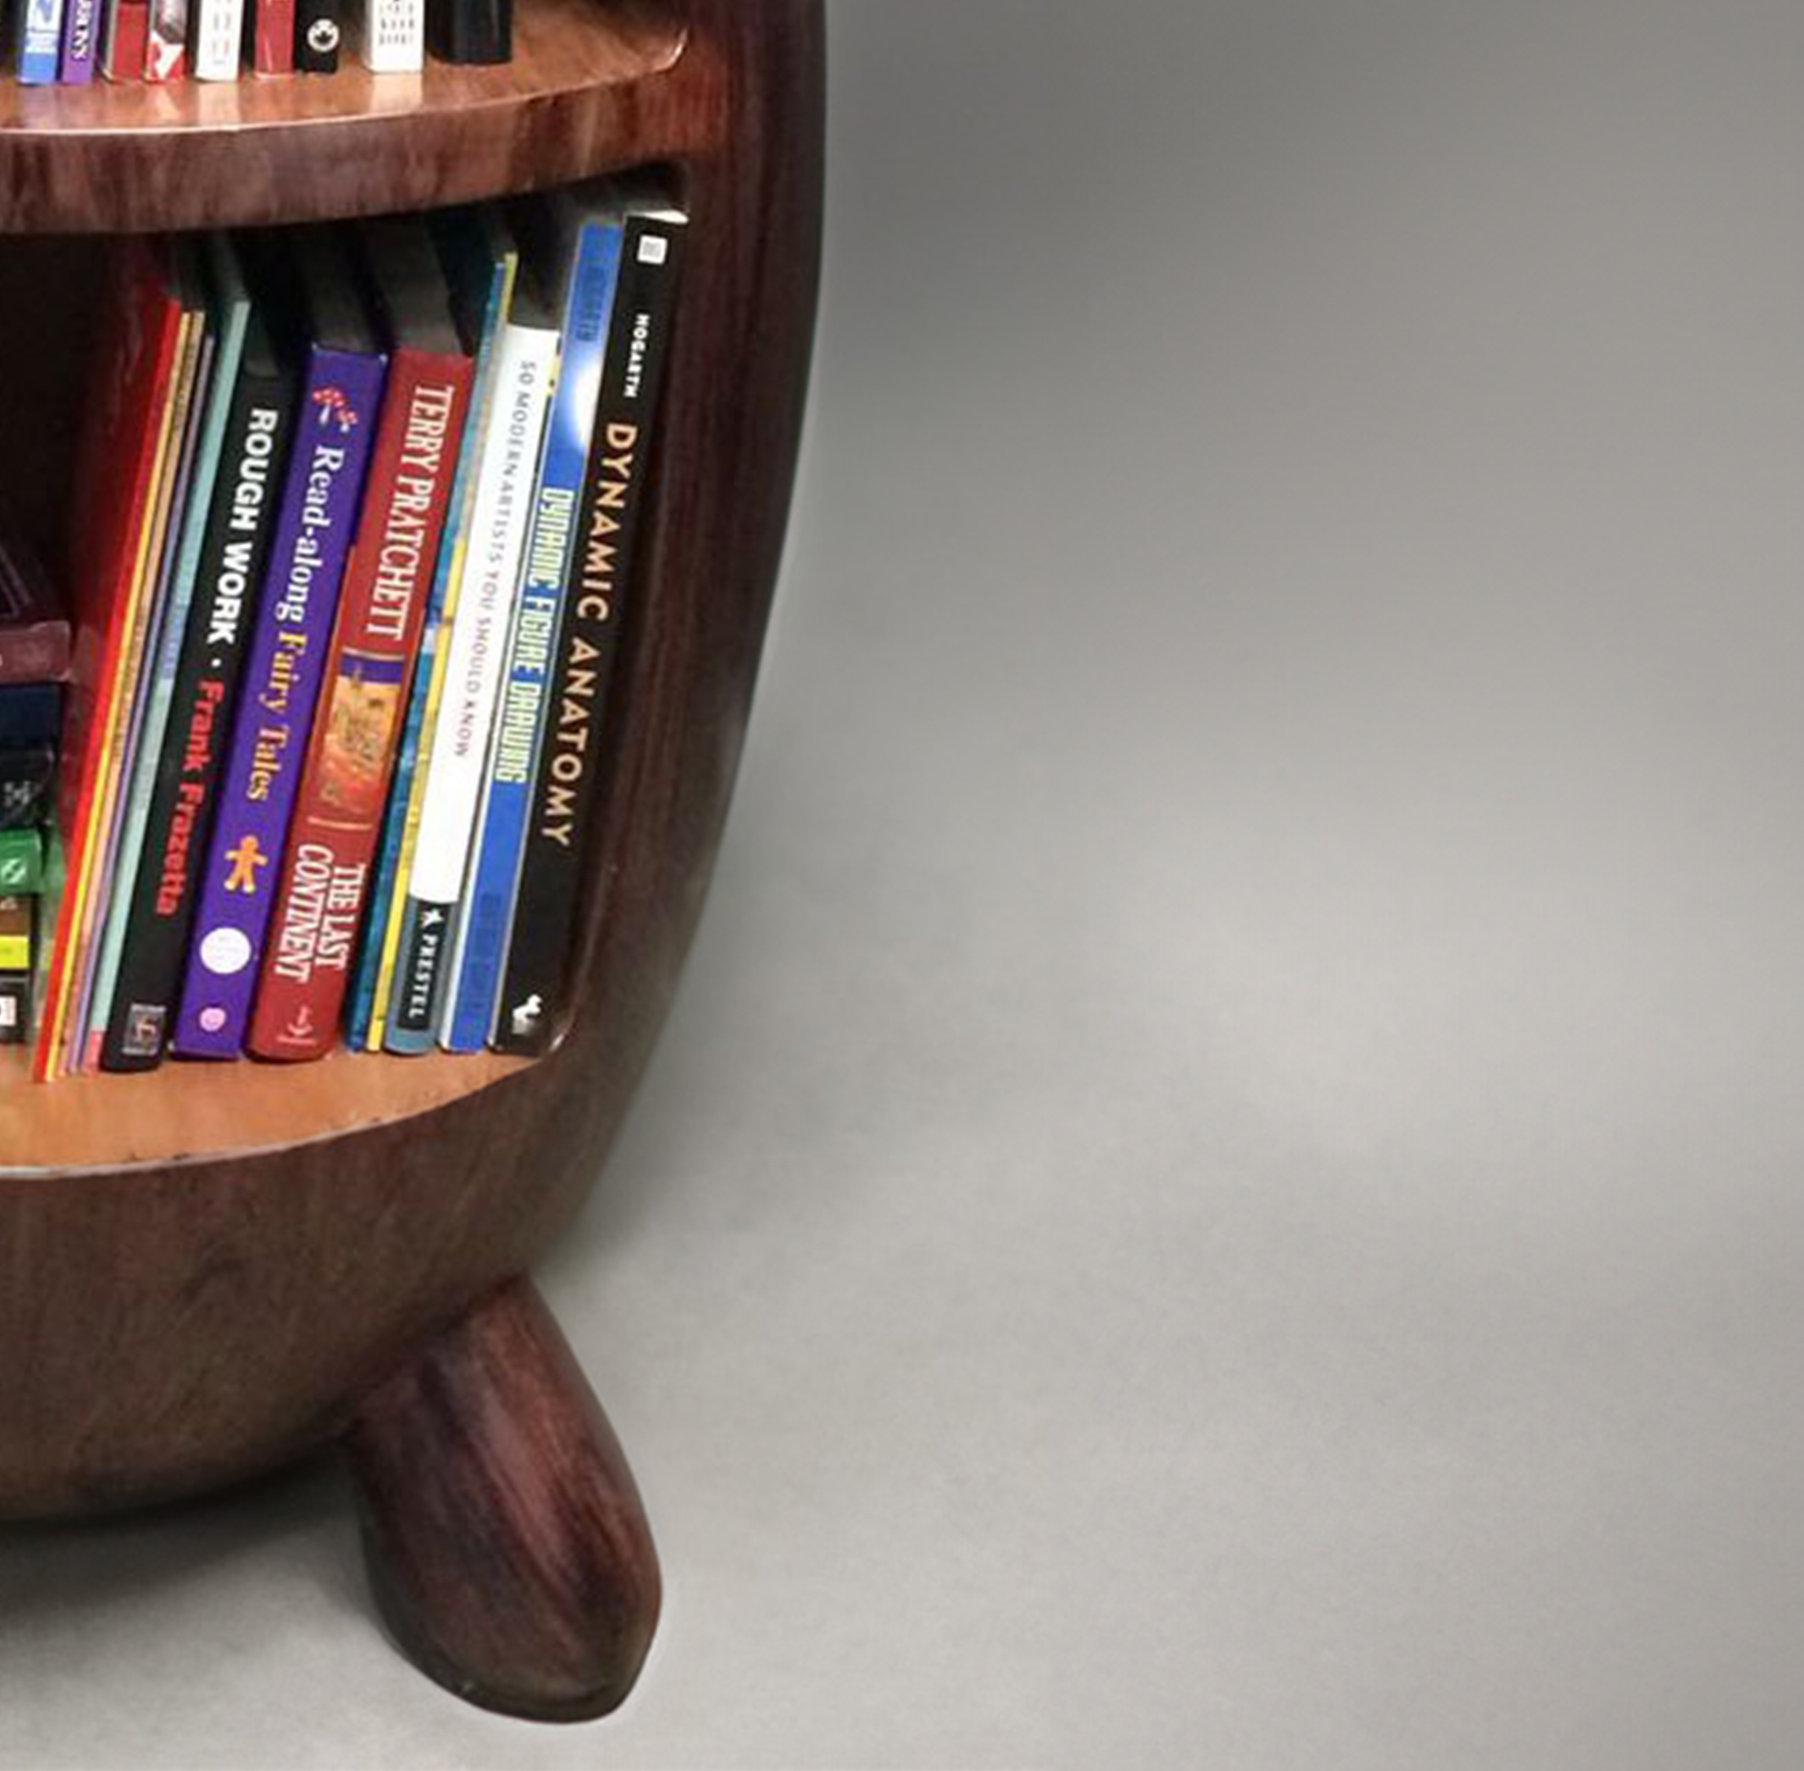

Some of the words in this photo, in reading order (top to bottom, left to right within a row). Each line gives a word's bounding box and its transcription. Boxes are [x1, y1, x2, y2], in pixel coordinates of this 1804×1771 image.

[517, 359, 537, 386] 50
[623, 313, 650, 398] HOGARTH
[228, 406, 279, 532] ROUGH
[398, 378, 455, 473] TERRY
[501, 391, 531, 478] MODERN
[274, 443, 344, 626] Read-along
[362, 473, 435, 641] PRATCHETT
[487, 480, 516, 564] ARTISTS
[526, 485, 576, 593] DYNAMIC
[576, 422, 636, 622] DYNAMIC
[206, 537, 253, 647] WORK
[478, 570, 500, 611] YOU
[256, 628, 308, 716] Fairy
[464, 615, 492, 694] SHOULD
[513, 595, 556, 675] FIGURE
[182, 678, 225, 775] Frank
[246, 721, 289, 804] Tales
[453, 698, 477, 757] KNOW
[494, 680, 542, 785] DRAWING
[540, 636, 600, 846] ANATOMY
[152, 780, 205, 918] Frazetta
[325, 858, 366, 914] THE
[271, 841, 335, 984] CONTINENT
[313, 911, 354, 972] LAST
[407, 931, 438, 1019] PRESTEL
